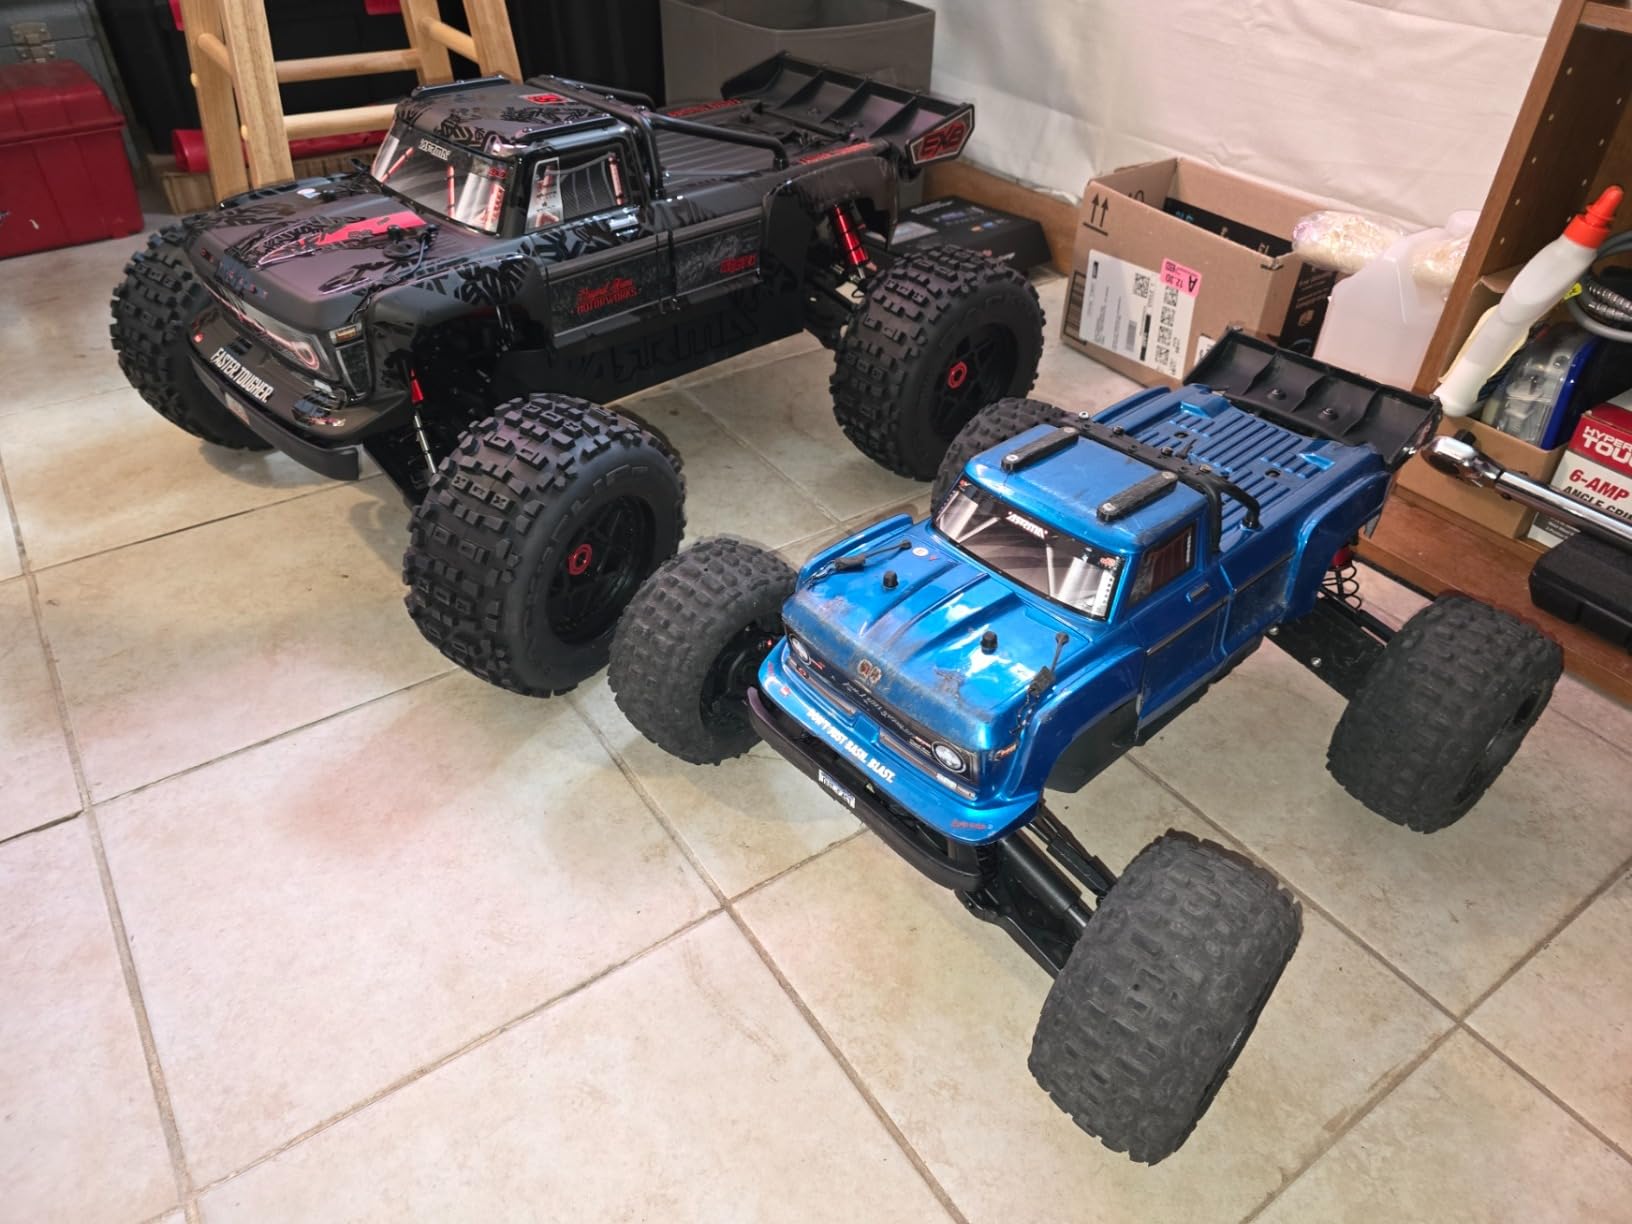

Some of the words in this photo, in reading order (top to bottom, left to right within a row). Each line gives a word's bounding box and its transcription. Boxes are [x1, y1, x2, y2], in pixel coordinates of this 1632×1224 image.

[1188, 275, 1199, 293] A
[1581, 433, 1632, 470] TOU
[1583, 425, 1632, 454] HYPER
[1569, 469, 1630, 501] 6-AMP
